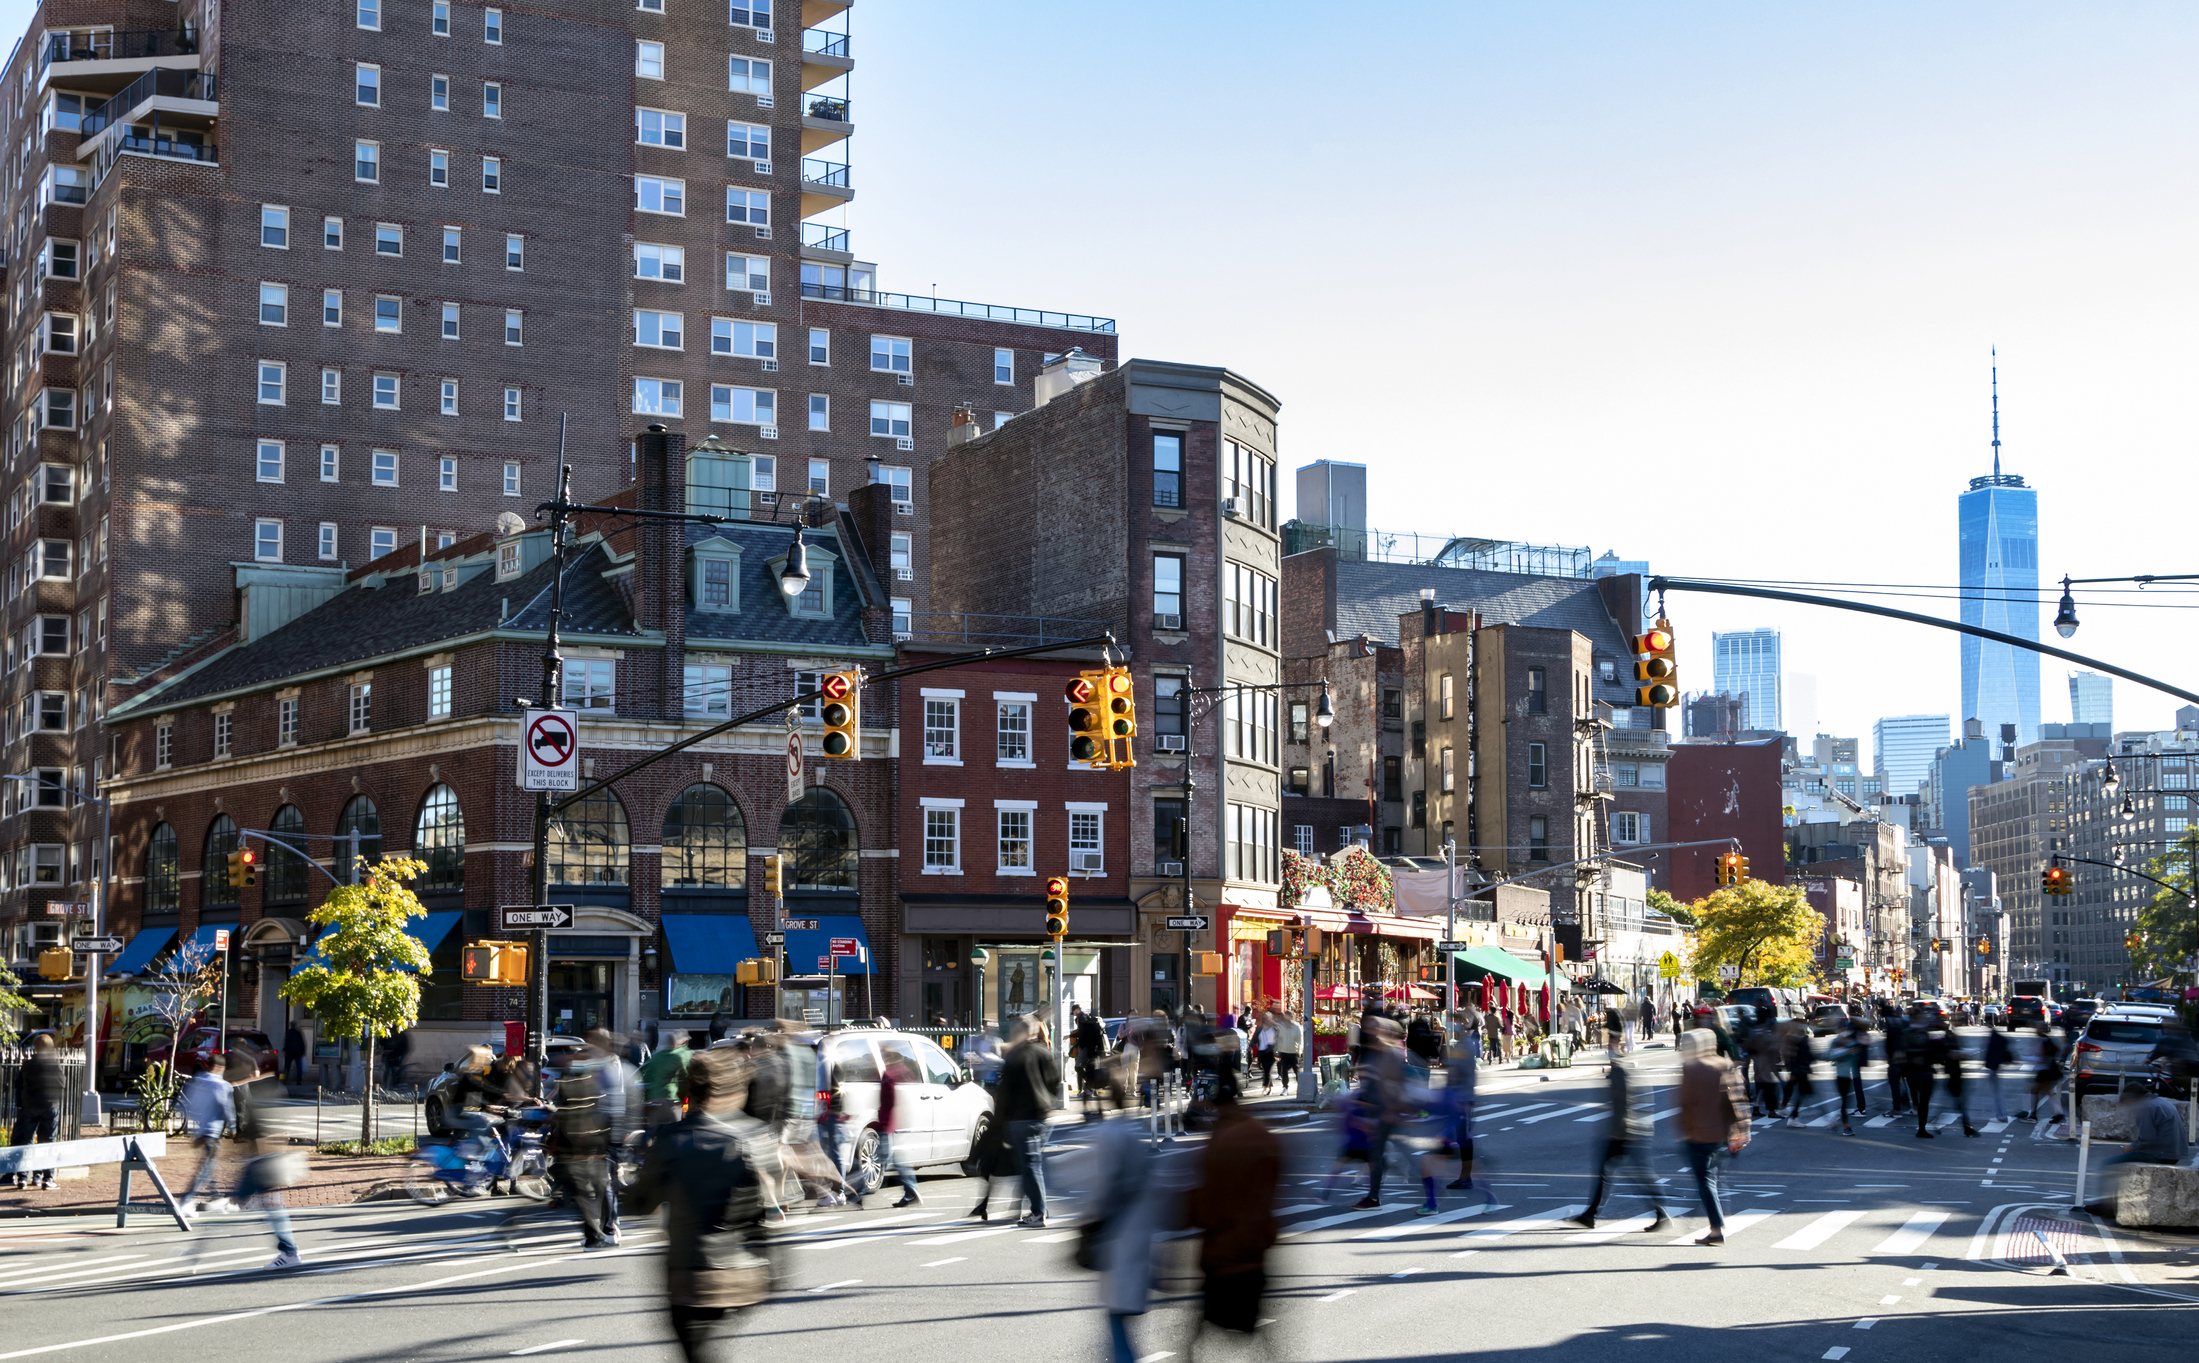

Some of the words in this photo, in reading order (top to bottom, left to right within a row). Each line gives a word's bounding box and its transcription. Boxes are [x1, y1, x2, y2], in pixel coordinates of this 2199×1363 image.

[50, 904, 73, 914] GROVE
[77, 904, 86, 914] ST
[512, 913, 532, 922] ONE
[541, 913, 562, 922] WAY
[785, 920, 806, 929] GROVE
[809, 920, 817, 929] ST
